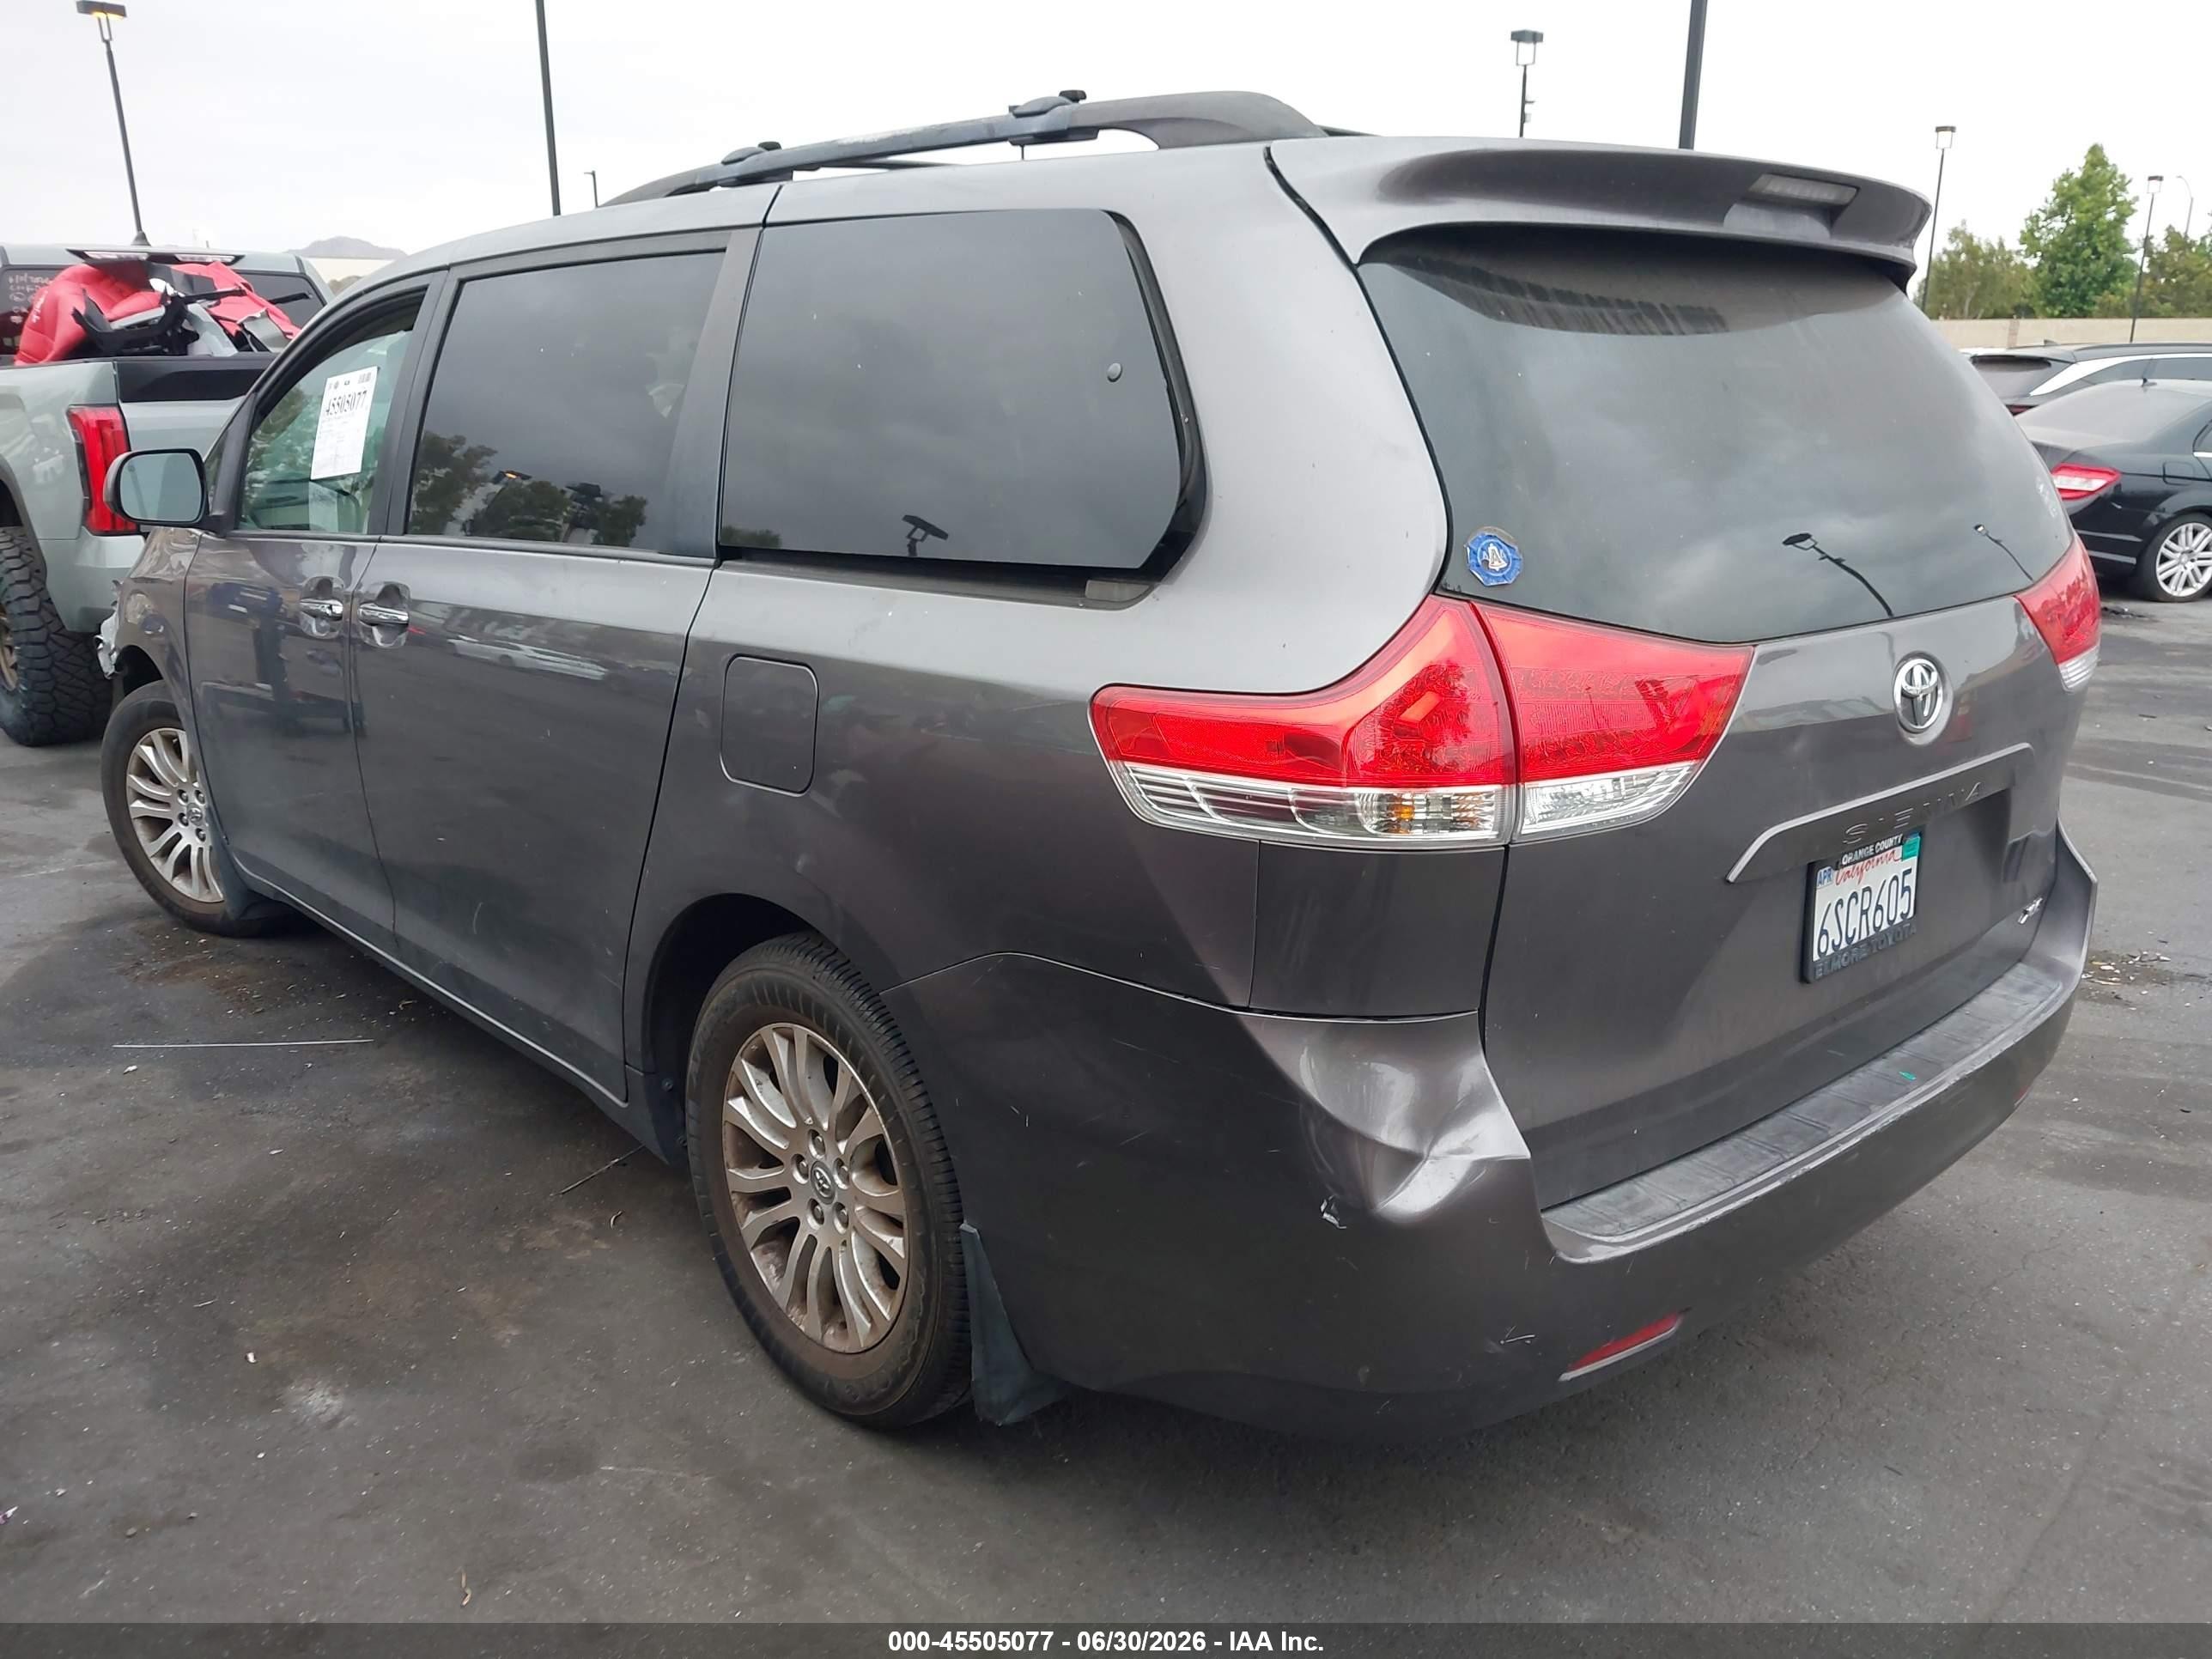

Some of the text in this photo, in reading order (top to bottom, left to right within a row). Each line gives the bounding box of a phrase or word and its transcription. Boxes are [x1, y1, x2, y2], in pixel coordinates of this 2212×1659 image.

[325, 390, 367, 416] 45505077
[1843, 781, 1982, 845] SEA
[1842, 842, 1875, 866] ORANGE
[1875, 834, 1903, 854] COUNTY
[1817, 869, 1833, 886] APR
[1835, 848, 1901, 885] California
[1817, 868, 1913, 957] 6SCR605
[1870, 924, 1917, 951] TOYOTA
